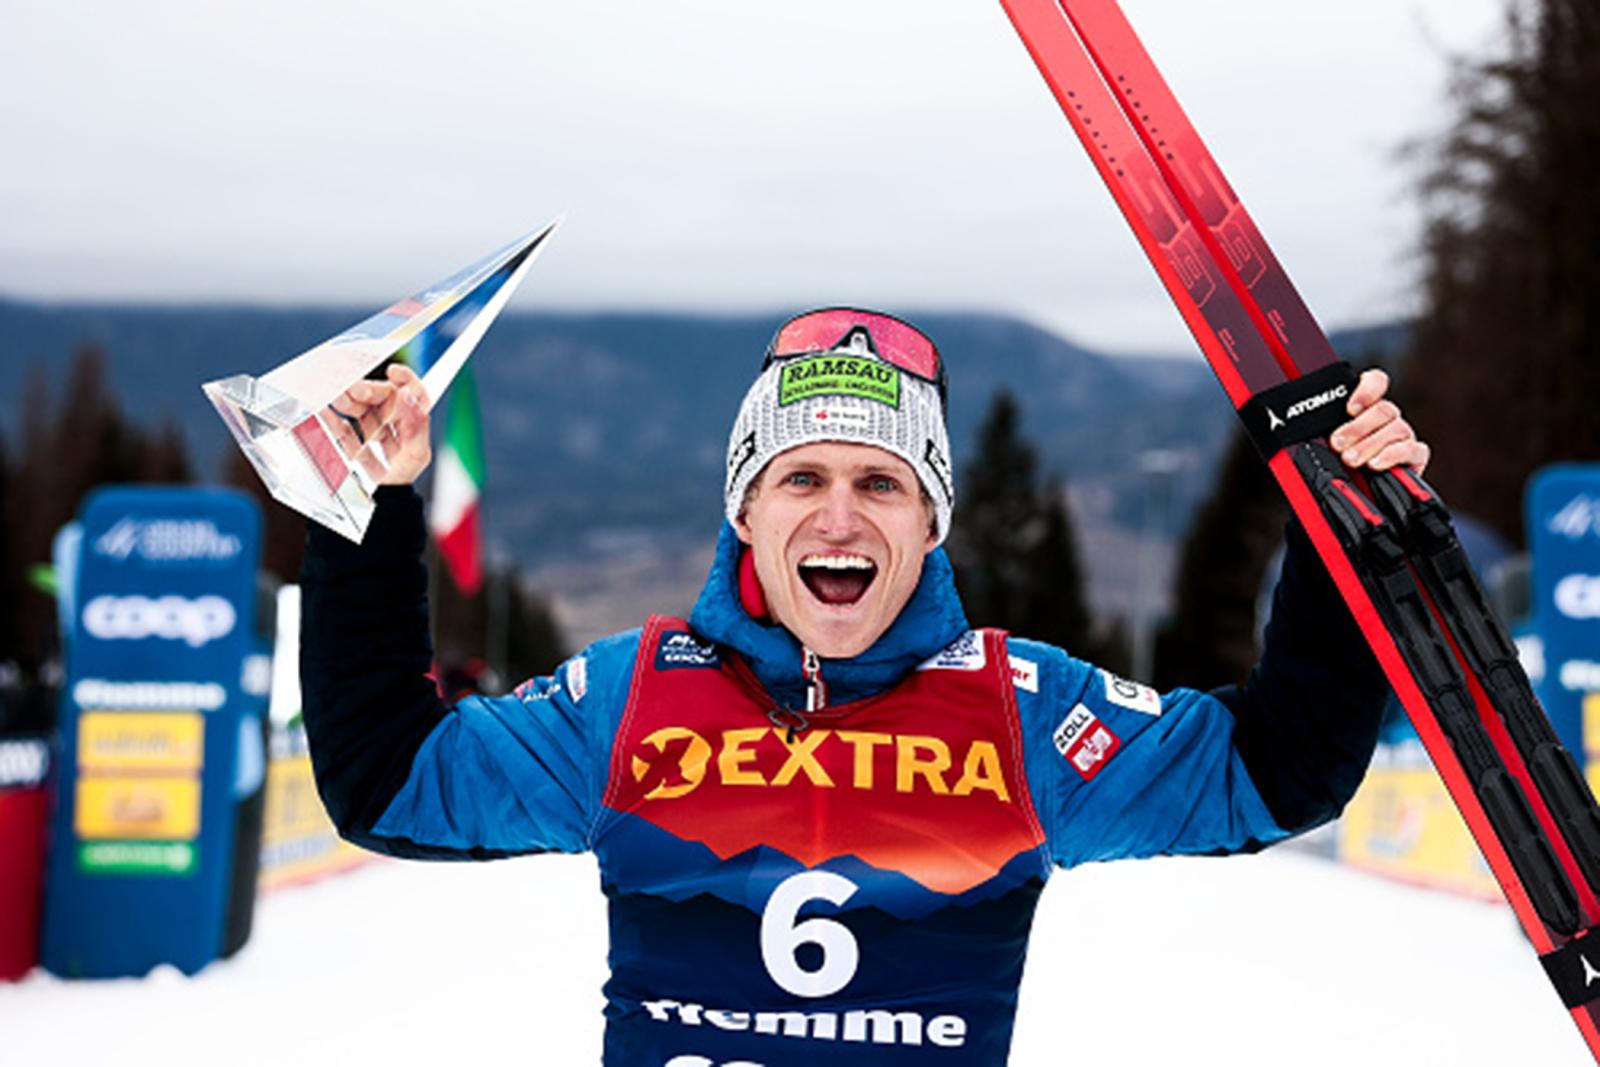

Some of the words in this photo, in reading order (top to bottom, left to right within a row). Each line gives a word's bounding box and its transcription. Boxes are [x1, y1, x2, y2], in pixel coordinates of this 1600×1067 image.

[788, 360, 892, 384] RAMSAU
[1286, 384, 1349, 419] ATOMIC
[83, 594, 237, 648] coop
[1055, 711, 1091, 749] ZOLL
[716, 727, 1011, 803] EXTRA
[759, 869, 860, 999] 6
